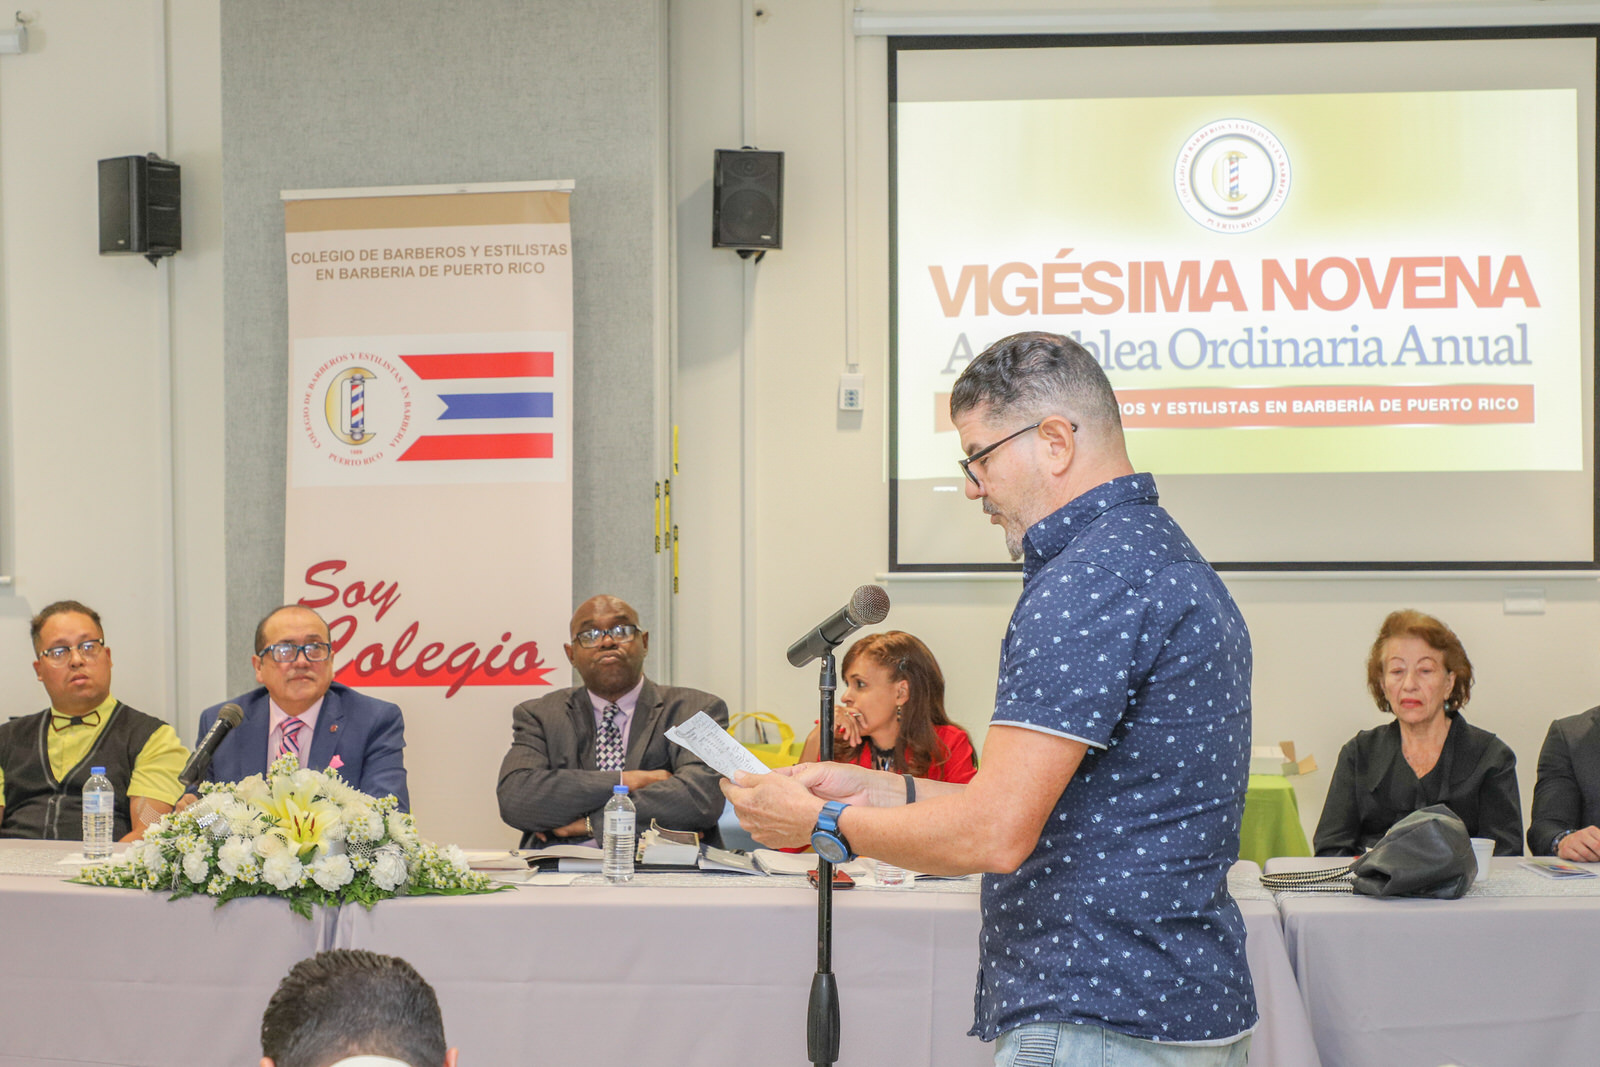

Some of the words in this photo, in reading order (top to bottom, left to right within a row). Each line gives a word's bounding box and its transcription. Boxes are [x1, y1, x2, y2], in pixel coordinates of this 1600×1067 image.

[290, 249, 355, 265] COLEGIO
[359, 248, 379, 262] DE
[383, 246, 466, 260] BARBEROS
[470, 245, 480, 257] Y
[484, 243, 568, 257] ESTILISTAS
[316, 268, 334, 280] EN
[339, 266, 415, 280] BARBERIA
[419, 265, 439, 277] DE
[443, 263, 504, 276] PUERTO
[508, 262, 545, 274] RICO
[927, 248, 1248, 317] VIGÉSIMA
[1261, 255, 1542, 312] NOVENA
[1168, 324, 1388, 371] Ordinaria
[1391, 323, 1533, 366] Anual
[308, 354, 348, 390] BARBEROS
[358, 352, 403, 383] ESTILISTAS
[1151, 402, 1162, 415] Y
[1167, 401, 1260, 415] ESTILISTAS
[1265, 400, 1287, 413] EN
[1292, 397, 1375, 413] BARBERÍA
[1380, 399, 1402, 412] DE
[1407, 398, 1472, 412] PUERTO
[1478, 397, 1519, 411] RICO
[303, 406, 321, 449] COLEGIO
[328, 452, 362, 466] PUERTO
[363, 451, 384, 465] RICO
[298, 560, 402, 622] Soy
